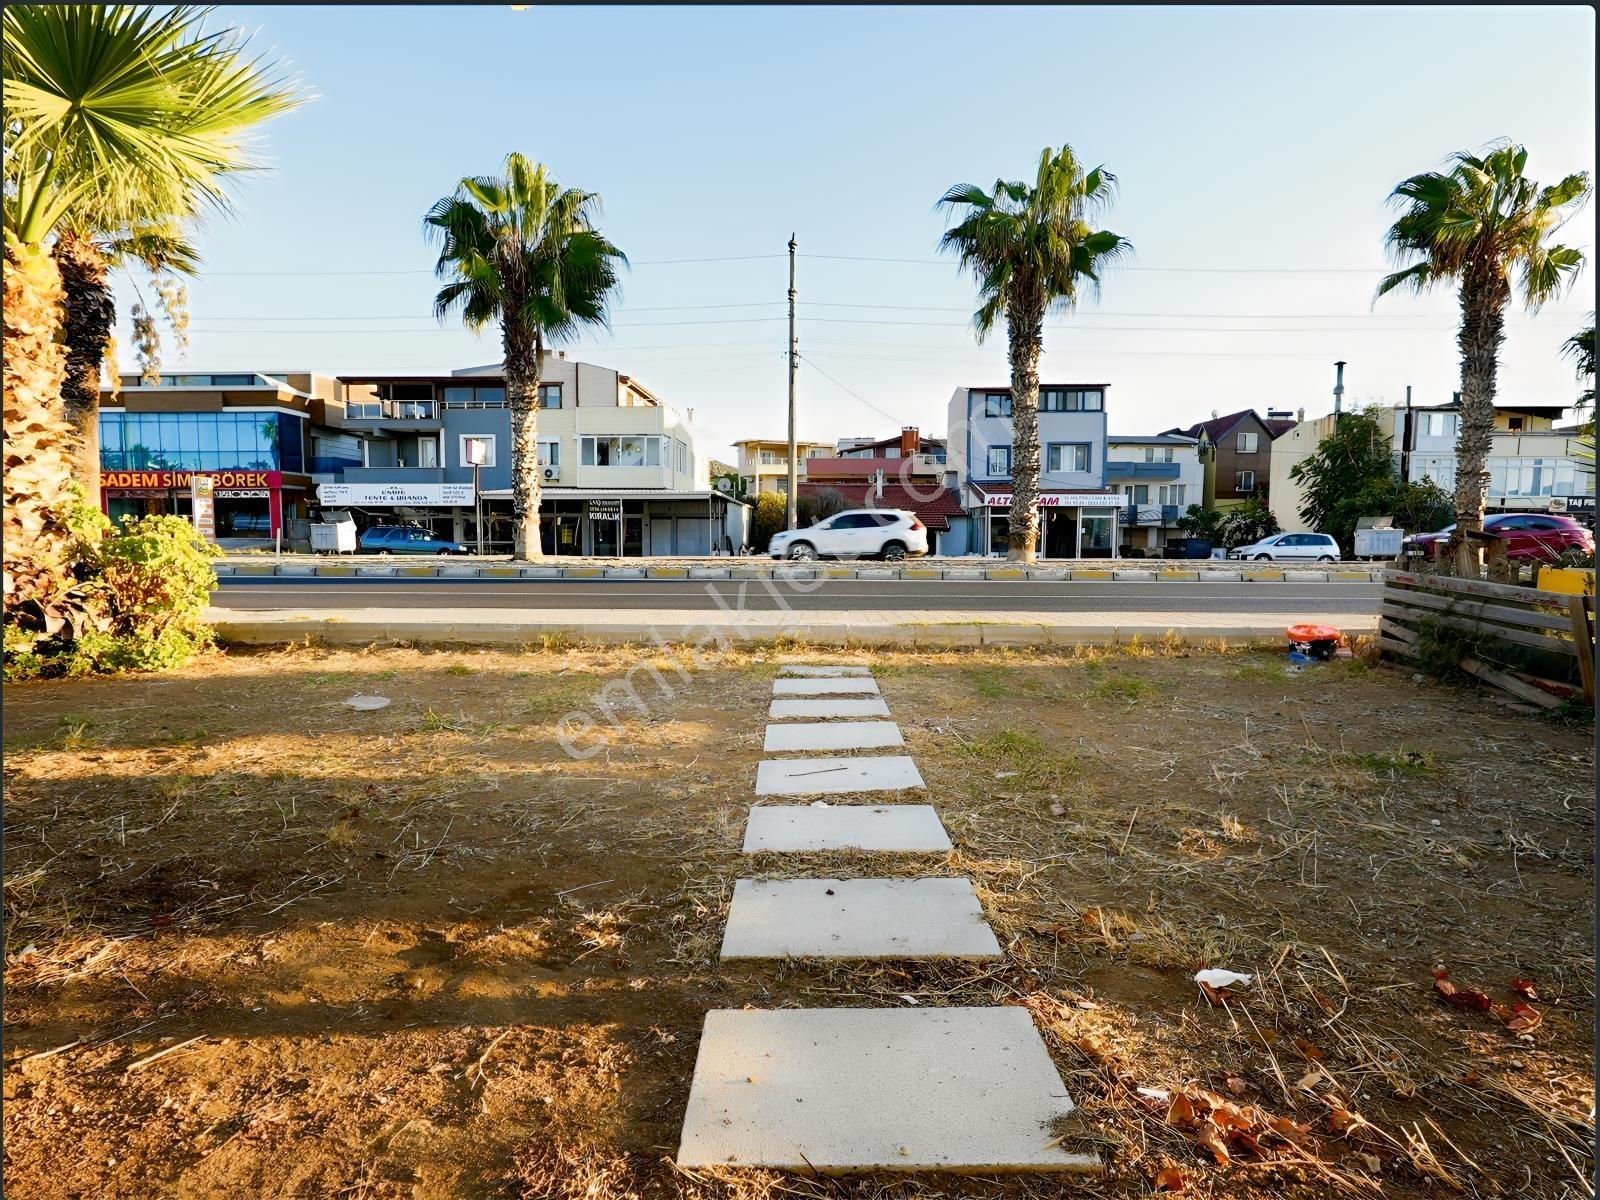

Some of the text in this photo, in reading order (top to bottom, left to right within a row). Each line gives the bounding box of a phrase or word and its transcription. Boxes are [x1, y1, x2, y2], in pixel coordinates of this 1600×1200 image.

[163, 471, 207, 487] SİM
[211, 471, 268, 487] BÖREK
[987, 496, 1014, 506] ALT
[1038, 497, 1060, 506] AM
[1568, 498, 1583, 507] TAŞ
[589, 512, 620, 520] KIRALIK
